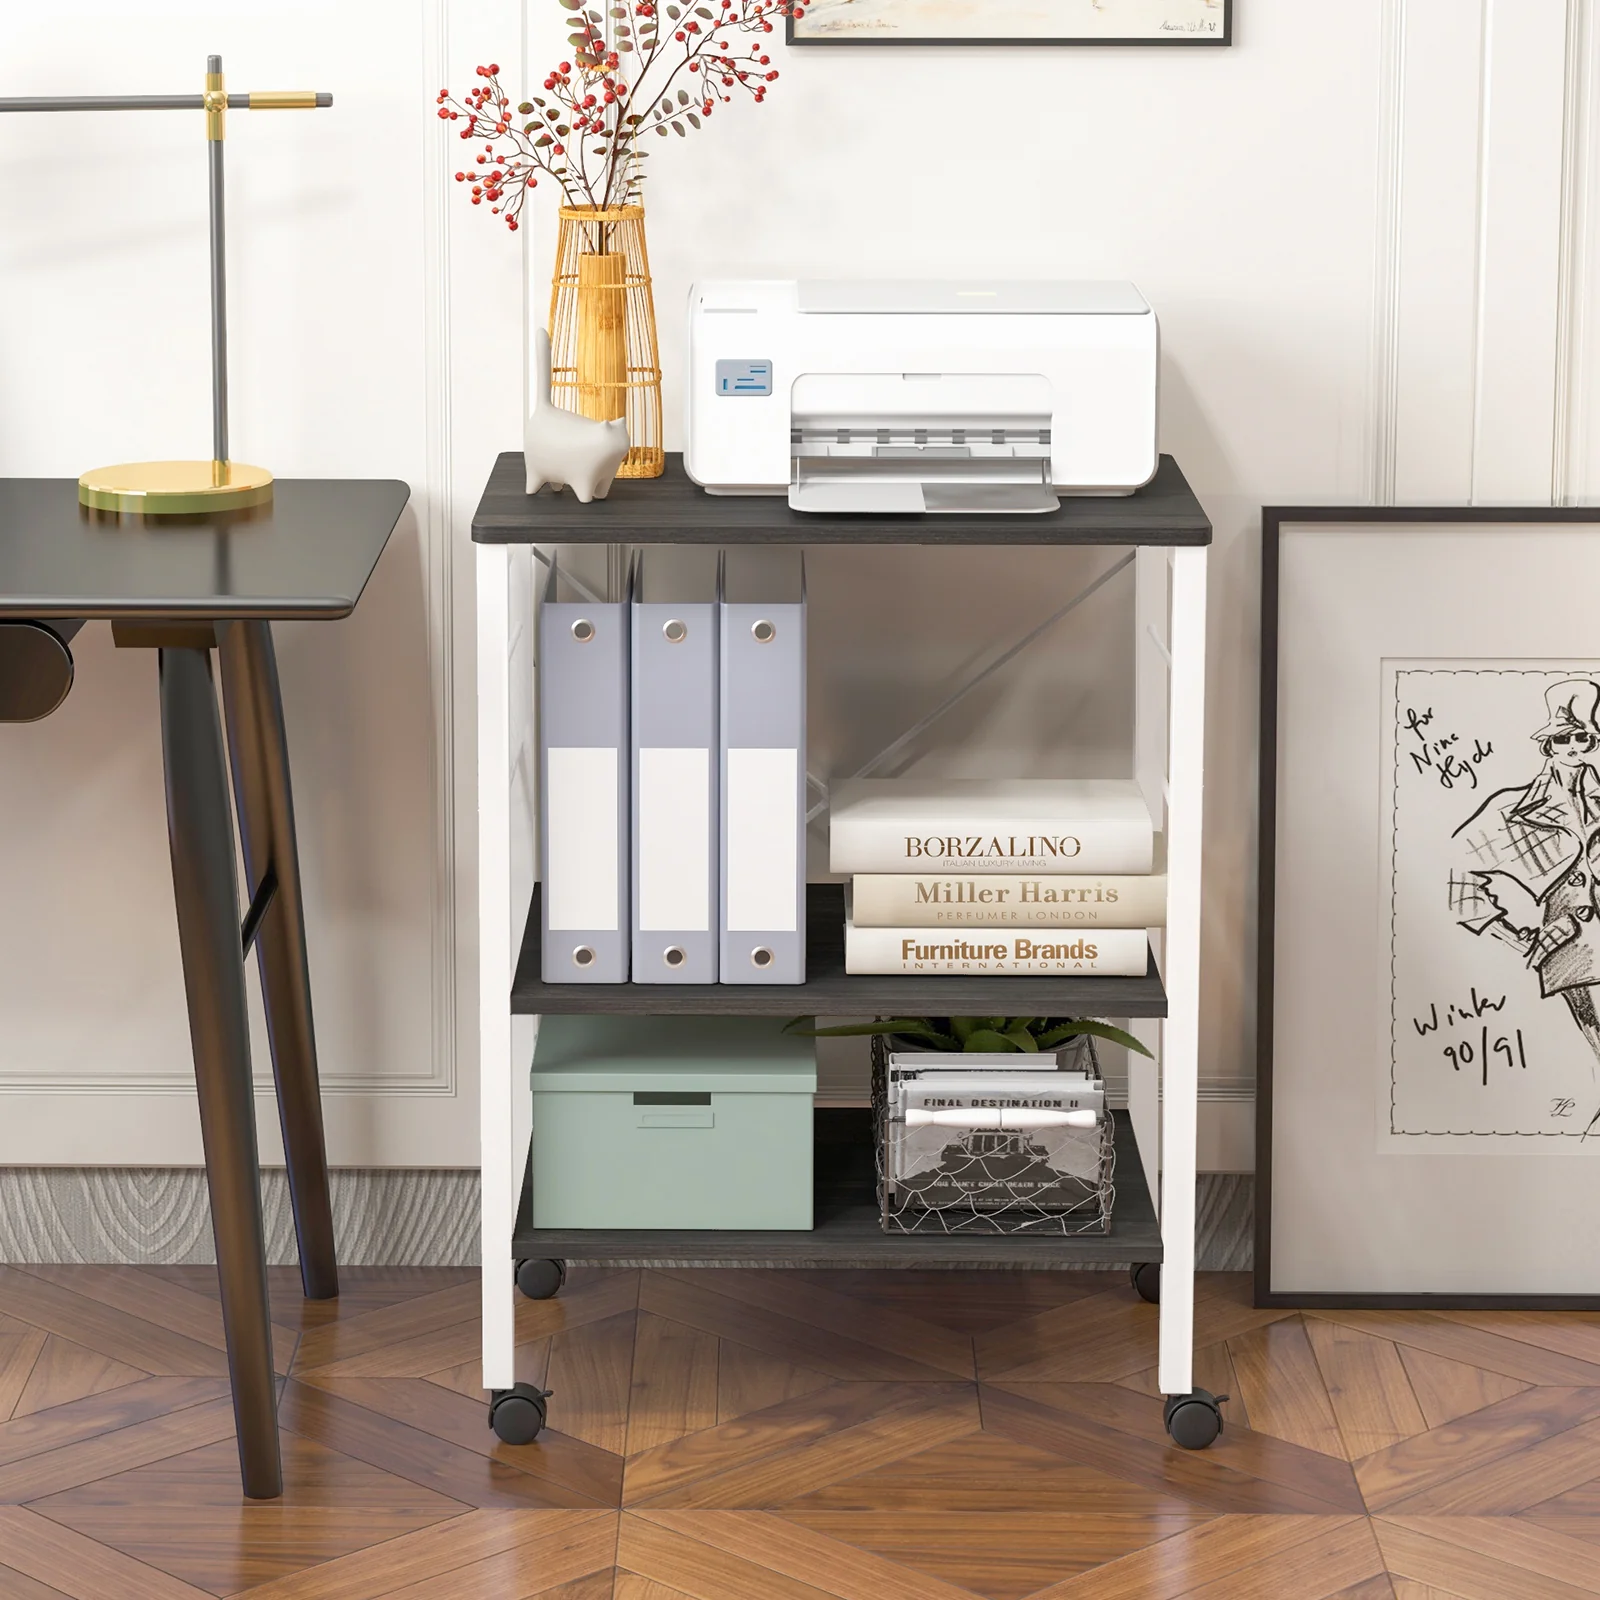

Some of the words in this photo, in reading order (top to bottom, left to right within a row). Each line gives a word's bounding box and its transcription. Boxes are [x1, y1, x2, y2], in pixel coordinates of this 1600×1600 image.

[904, 836, 1081, 857] BORZALINO
[915, 881, 1010, 903] Miller
[1018, 881, 1119, 903] Harris
[937, 911, 1018, 920] PERFUMER
[1027, 911, 1098, 920] LONDON
[902, 939, 1007, 960] Furniture
[1014, 939, 1098, 960] Brands
[1442, 1025, 1527, 1087] 90/91
[923, 1098, 964, 1108] FINAL
[970, 1098, 1062, 1108] DESTINATION
[1069, 1099, 1080, 1109] II
